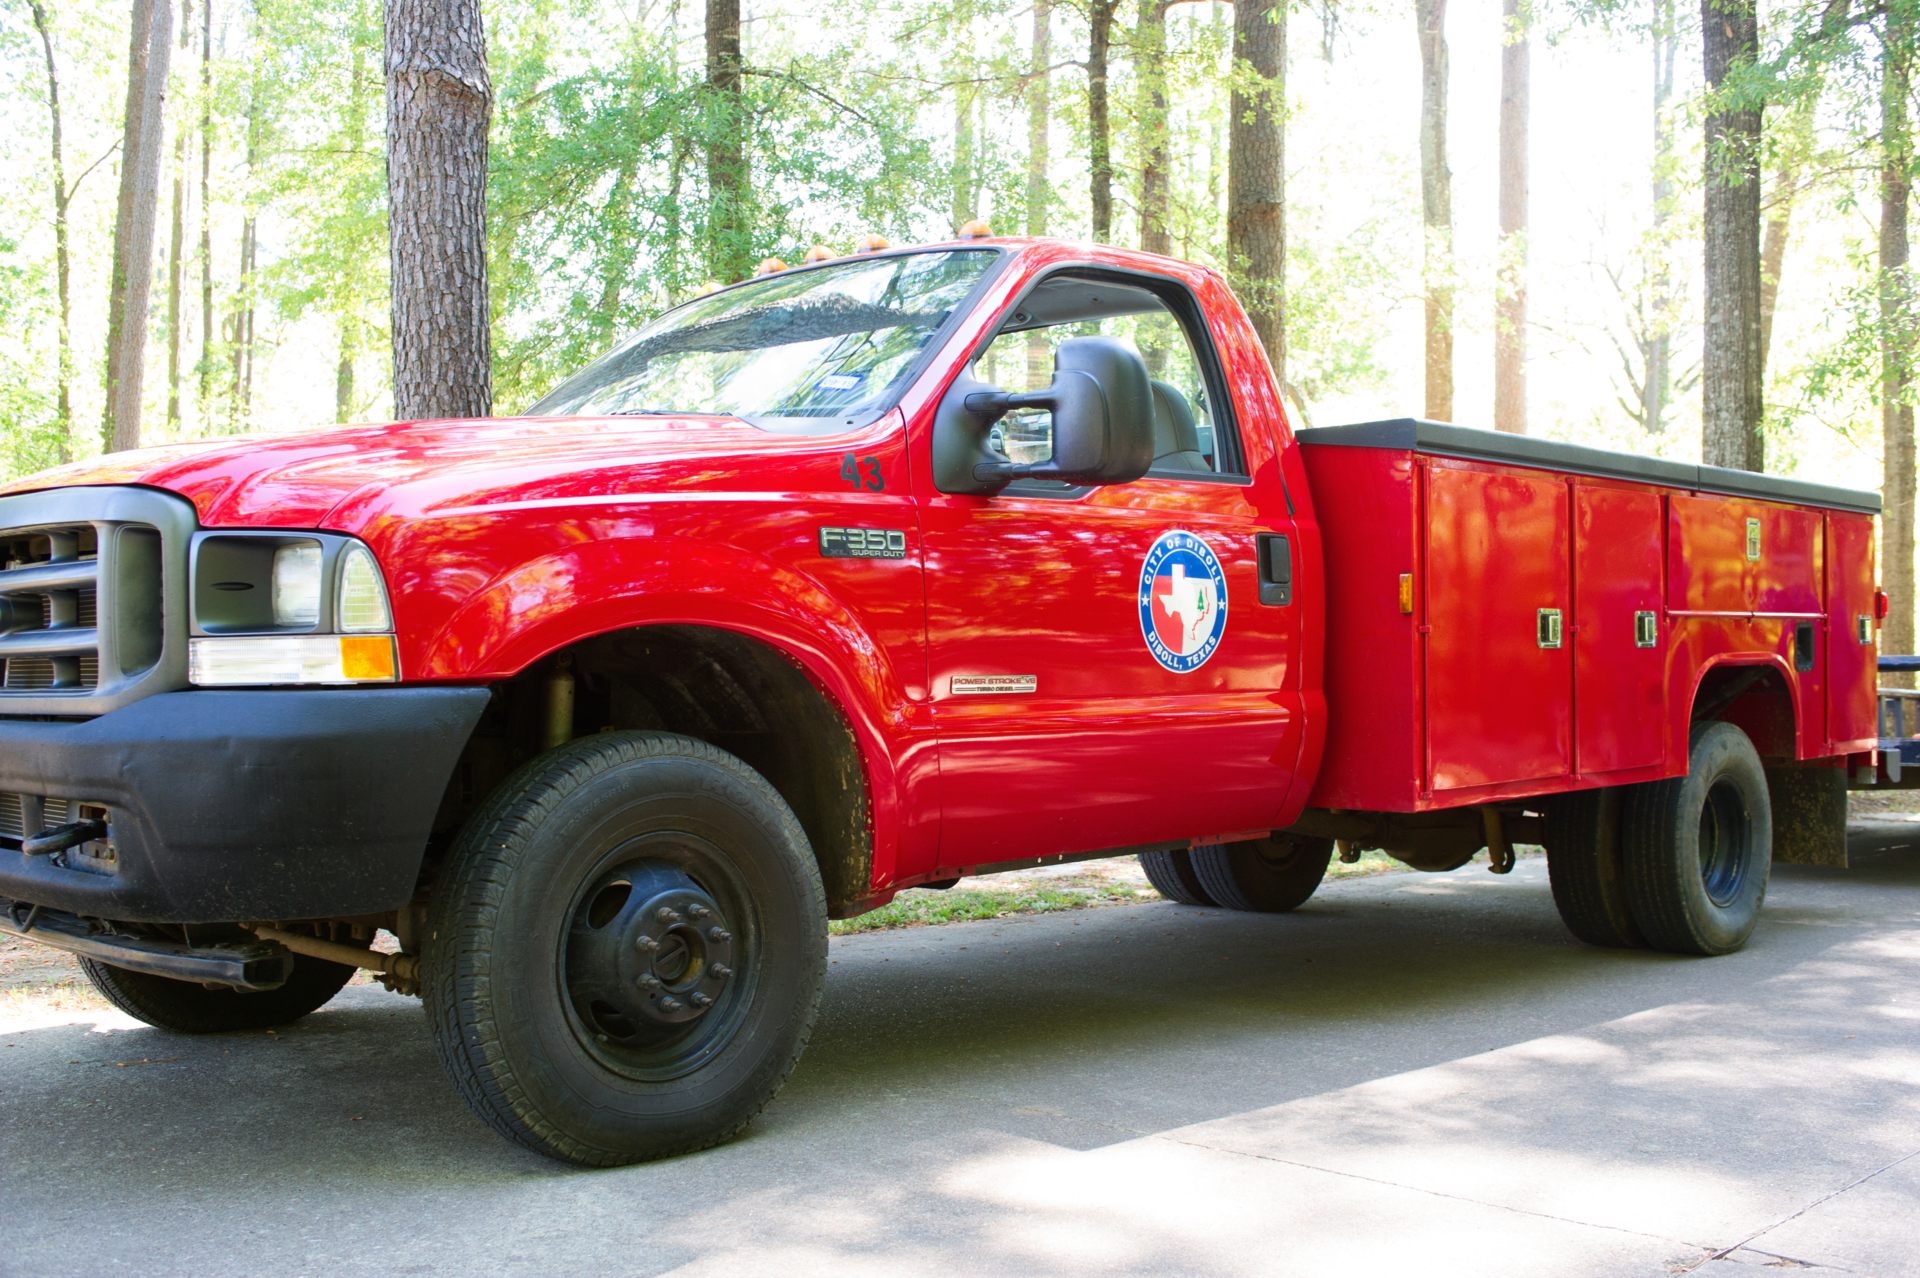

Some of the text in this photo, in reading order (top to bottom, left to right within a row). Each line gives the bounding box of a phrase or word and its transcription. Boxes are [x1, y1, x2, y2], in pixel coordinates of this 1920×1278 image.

[840, 453, 885, 492] 43
[829, 548, 848, 556] XL
[851, 549, 906, 558] SUPER DUTY
[1144, 537, 1222, 585] CITY OF DIBOLL
[1148, 631, 1217, 670] DIBOLL, TEXAS
[988, 677, 1022, 685] STROKE
